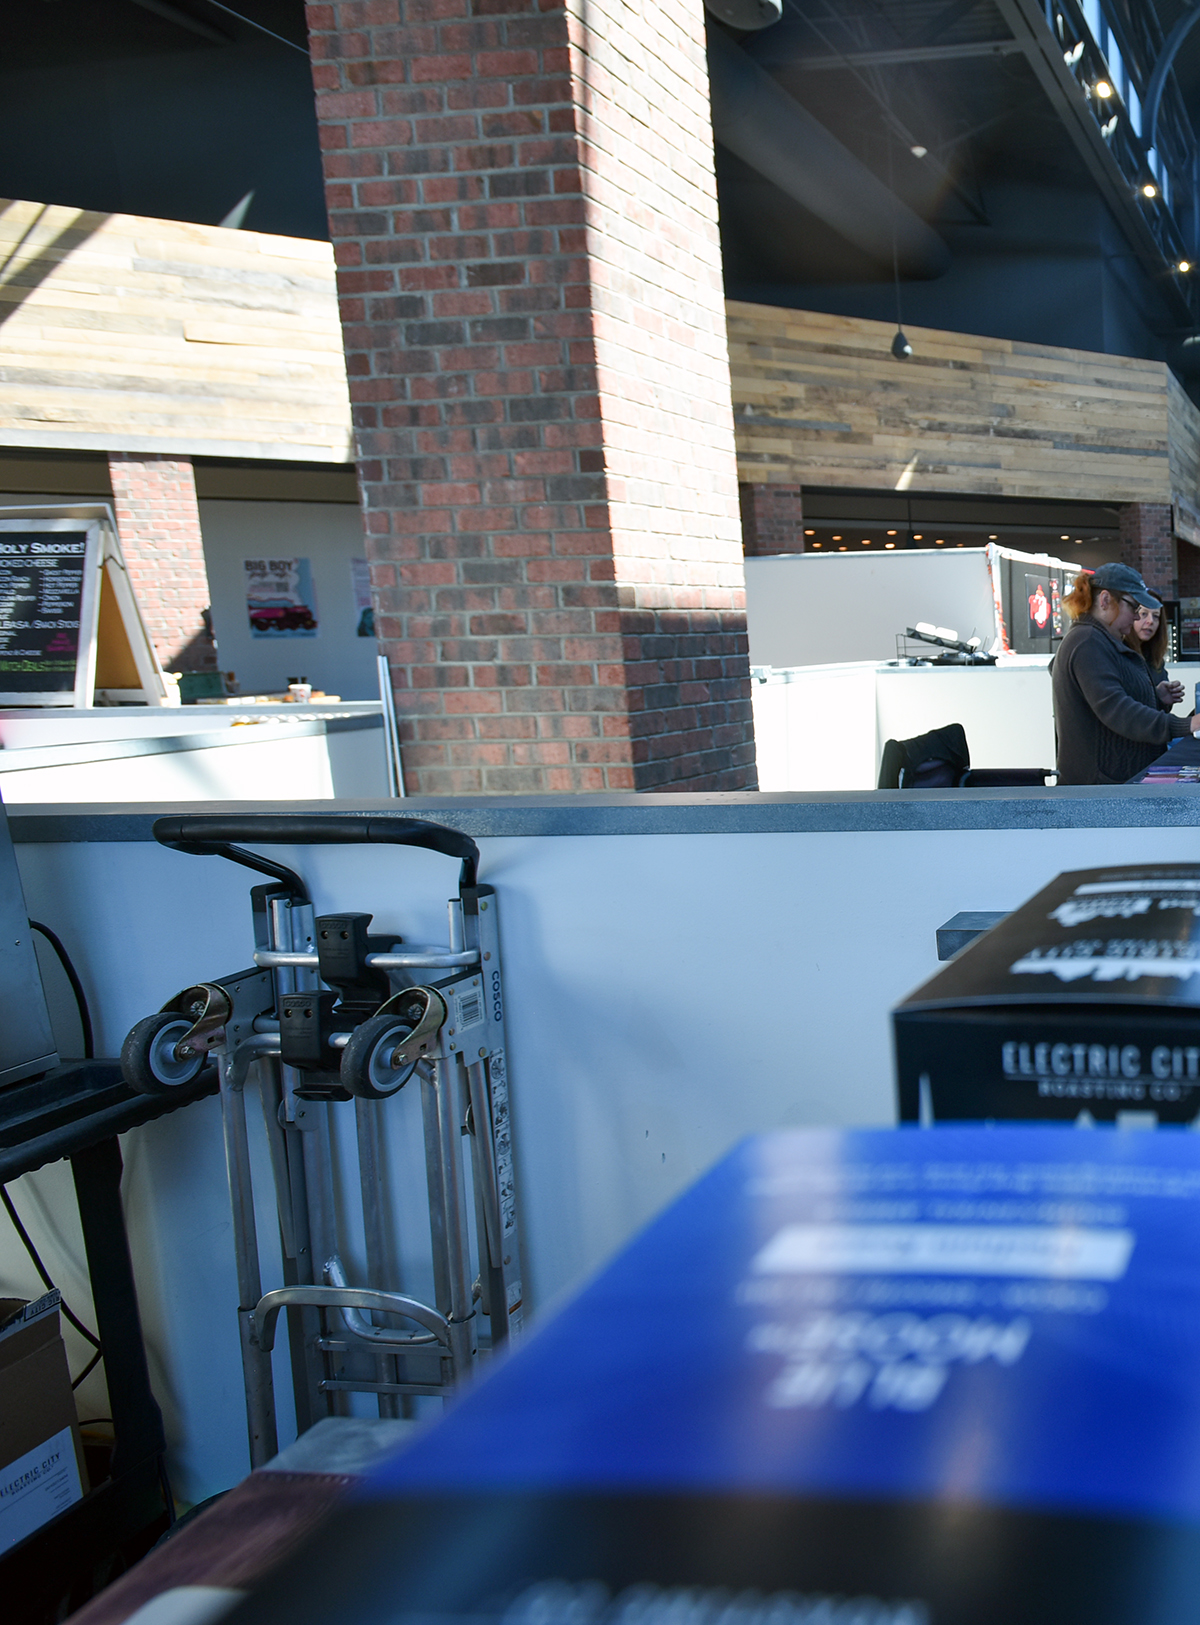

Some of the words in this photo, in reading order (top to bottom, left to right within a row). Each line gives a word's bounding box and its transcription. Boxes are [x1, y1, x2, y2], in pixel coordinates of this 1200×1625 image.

[244, 560, 267, 571] BIG
[269, 560, 293, 571] BOY
[492, 970, 502, 1022] COSCO
[1002, 1041, 1142, 1079] ELECTRIC
[0, 1467, 39, 1497] ELECTRIC
[42, 1452, 60, 1470] CITY
